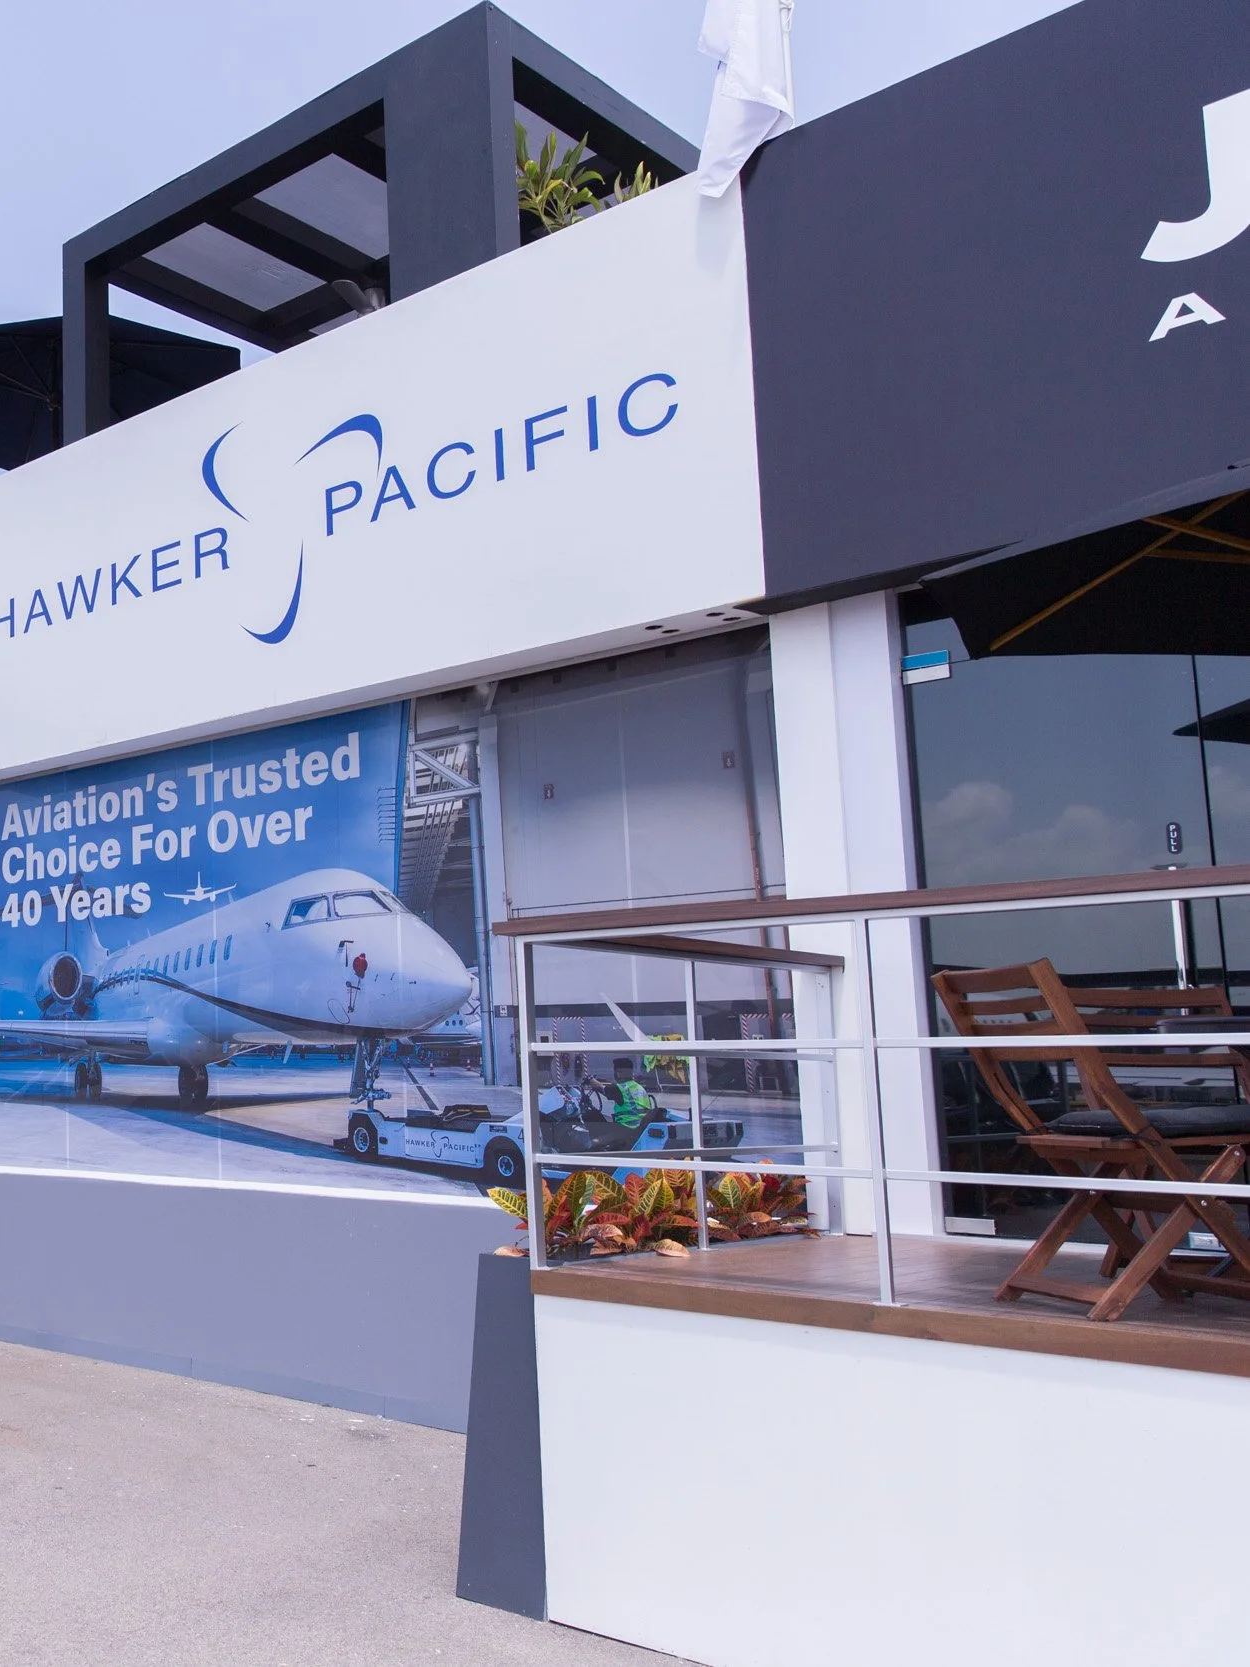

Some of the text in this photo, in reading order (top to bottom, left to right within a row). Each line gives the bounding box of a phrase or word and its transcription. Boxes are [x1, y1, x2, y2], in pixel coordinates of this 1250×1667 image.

[324, 372, 679, 537] PACIFIC
[1, 732, 361, 841] Aviation's Trusted
[1, 806, 313, 884] Choice For Over
[1169, 824, 1178, 852] PULL
[1, 882, 151, 928] 40 Years
[405, 1138, 475, 1153] HAWKER PACIFIC
